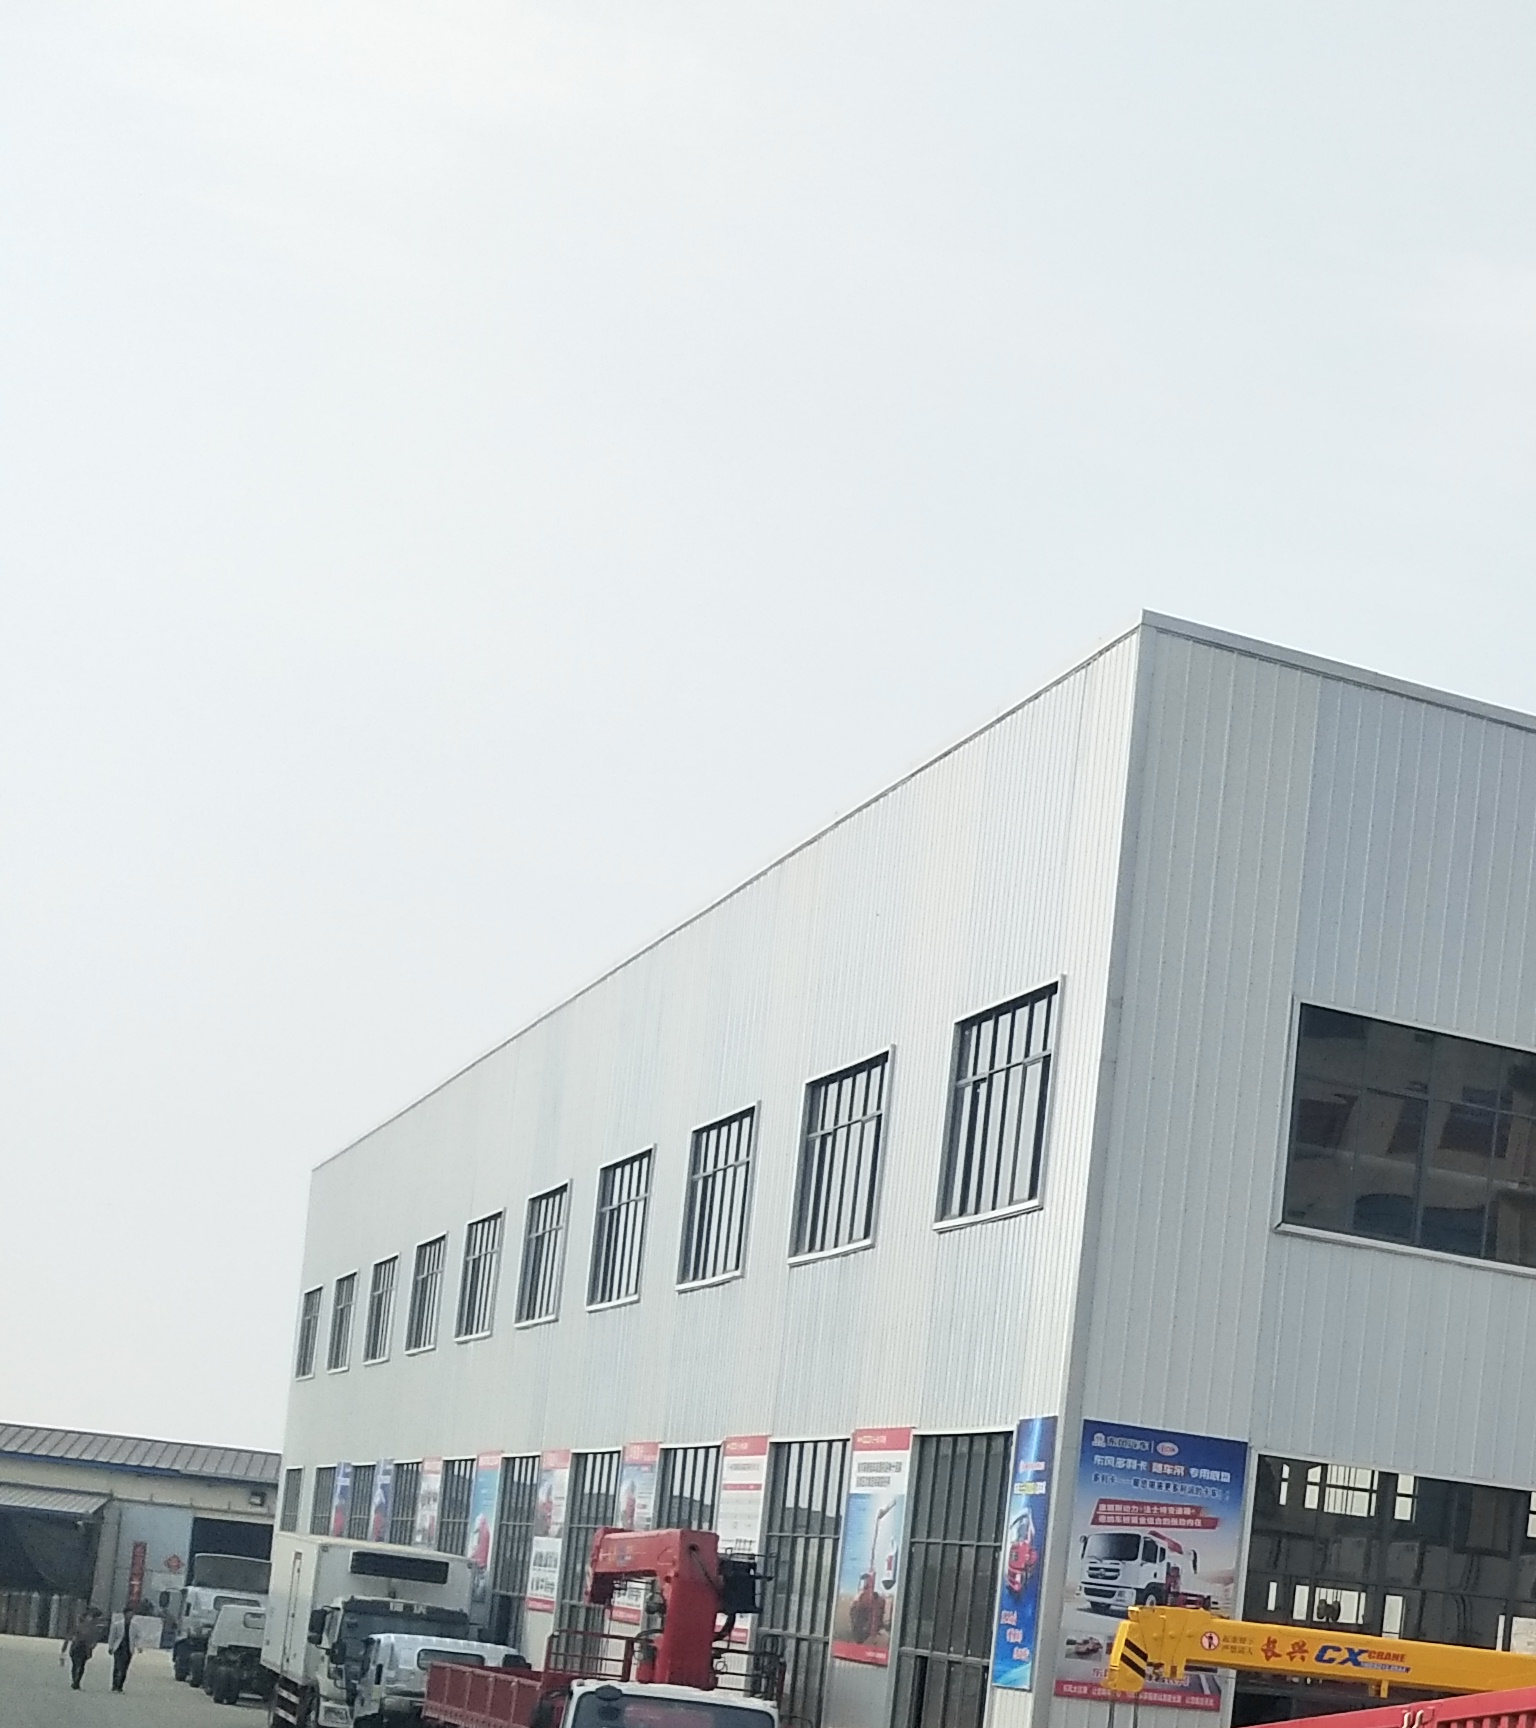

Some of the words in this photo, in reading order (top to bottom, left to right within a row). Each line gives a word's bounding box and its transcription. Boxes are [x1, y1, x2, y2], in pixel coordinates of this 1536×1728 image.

[1261, 1636, 1309, 1662] 长兴
[1314, 1645, 1368, 1667] CX
[1367, 1650, 1406, 1663] CRANE
